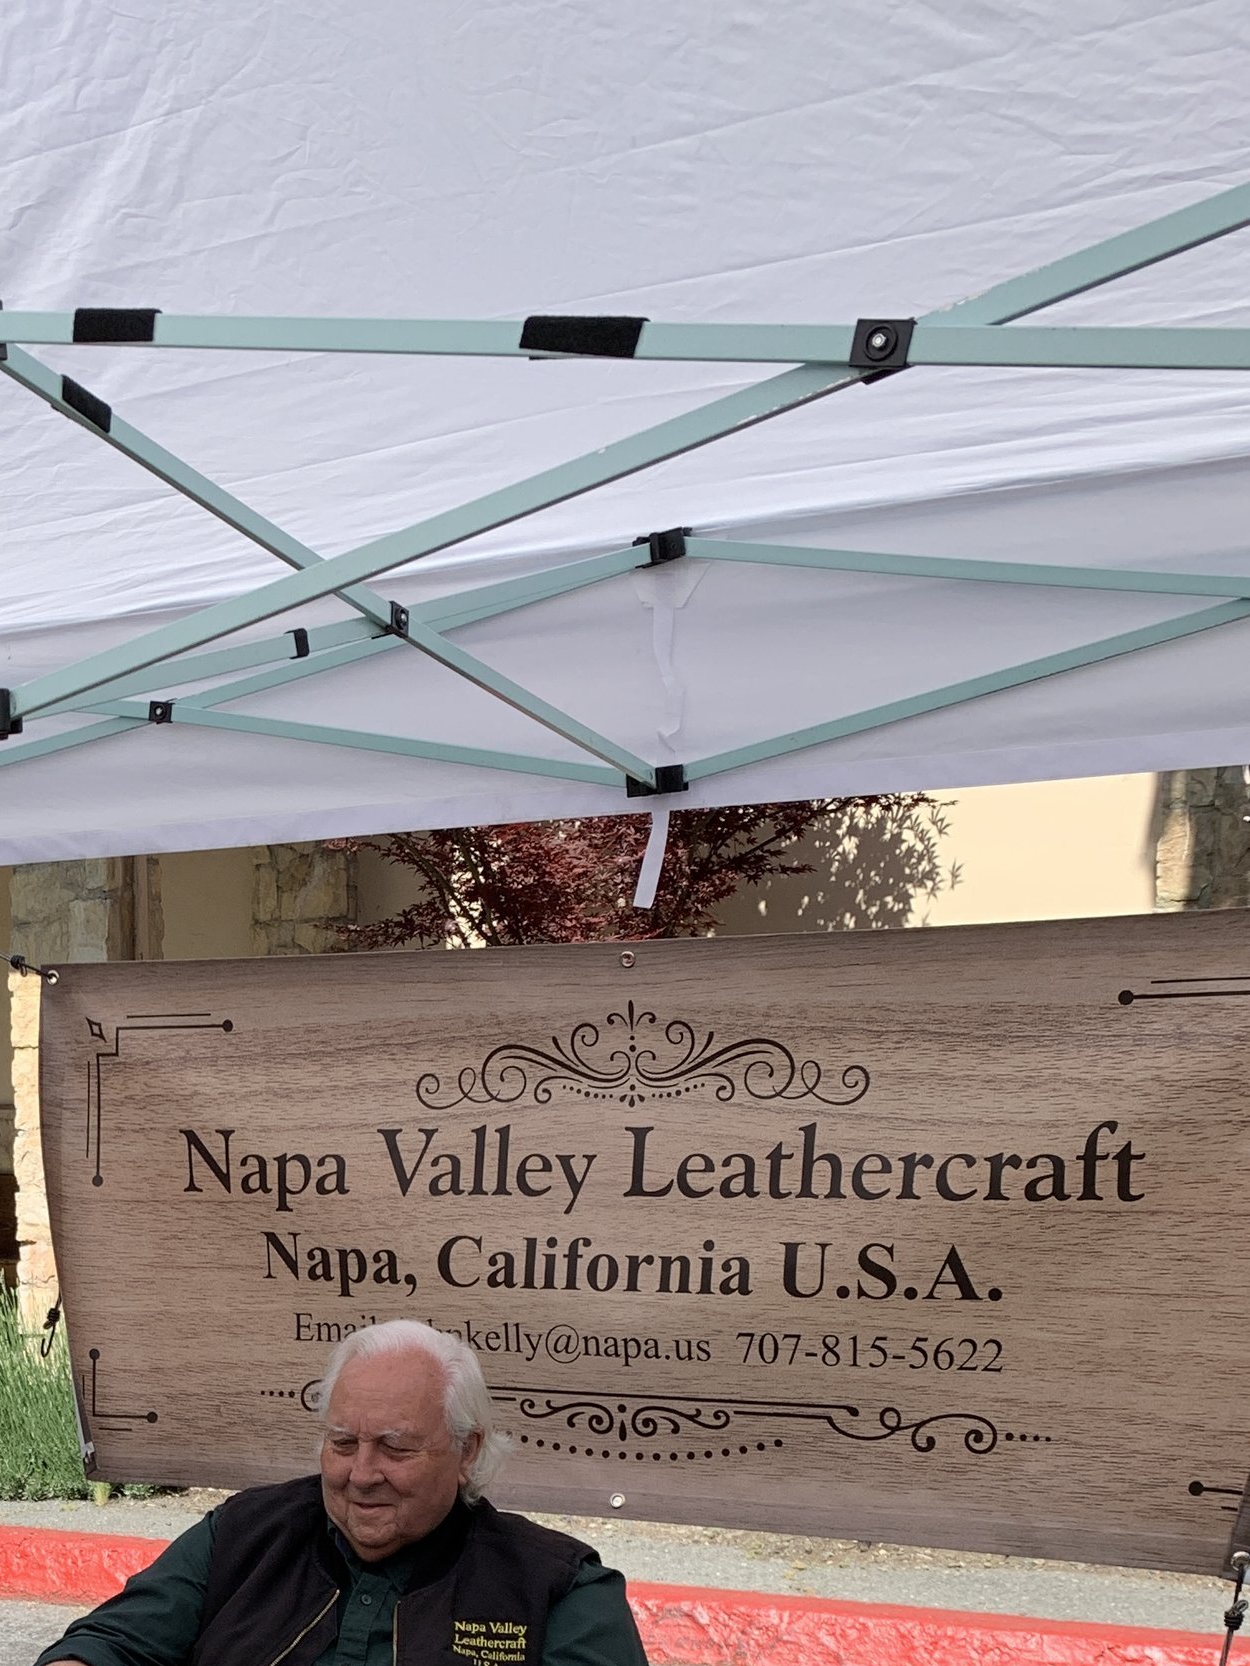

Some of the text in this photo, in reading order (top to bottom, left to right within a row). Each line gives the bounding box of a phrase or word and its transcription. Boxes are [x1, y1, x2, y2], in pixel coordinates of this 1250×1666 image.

[182, 1119, 1146, 1214] Napa Valley Leathercraft
[262, 1230, 1005, 1303] Napa, California U.S.A.
[426, 1318, 711, 1366] nkelly@napa.us
[736, 1332, 1004, 1373] 707-815-5622
[454, 1621, 527, 1636] Napa Valley
[454, 1633, 527, 1649] Leathercraft
[452, 1644, 525, 1662] Napa, California
